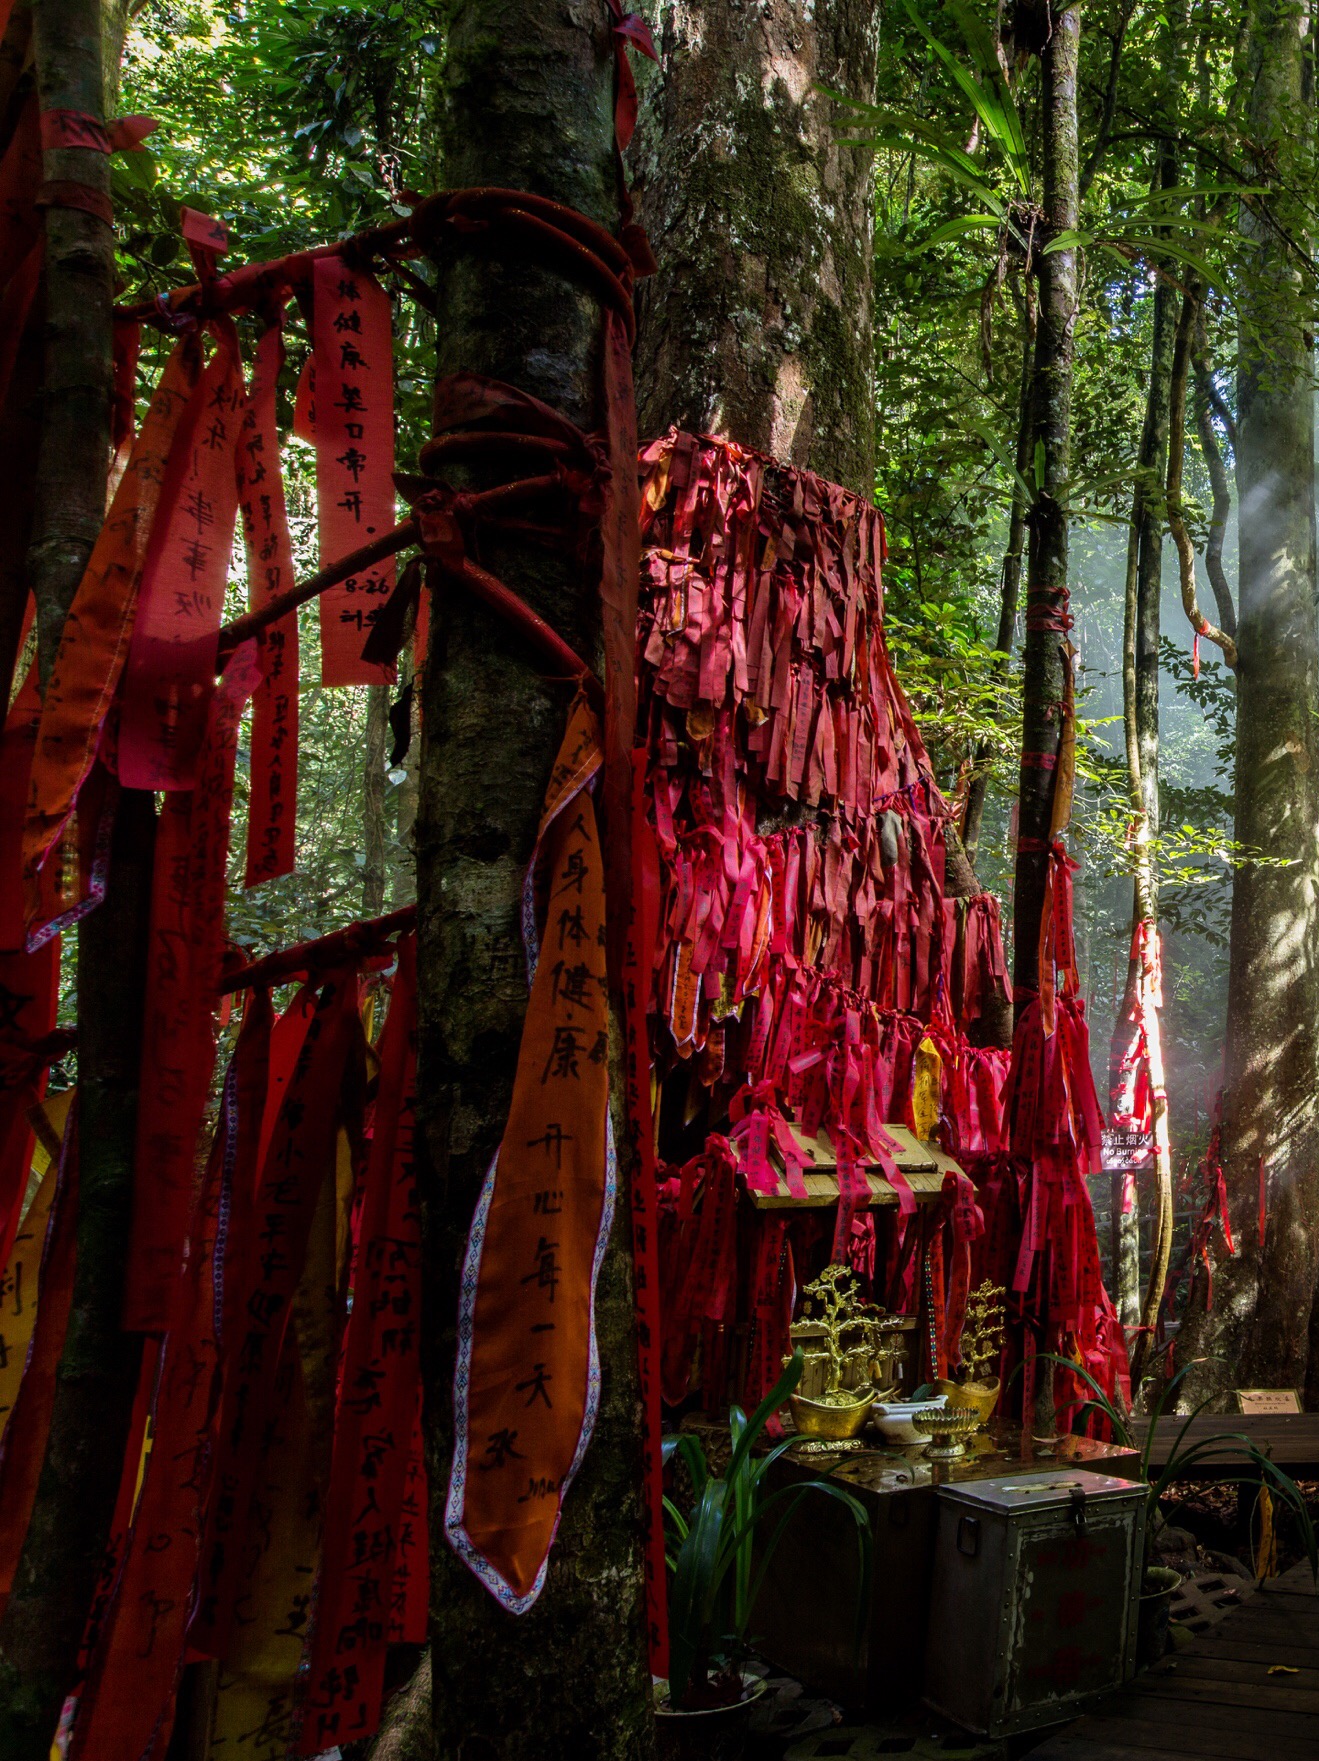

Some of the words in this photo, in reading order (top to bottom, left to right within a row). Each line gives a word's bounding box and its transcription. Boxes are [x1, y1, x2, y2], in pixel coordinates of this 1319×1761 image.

[1101, 1133, 1149, 1146] 禁止烟火
[1103, 1146, 1114, 1156] No
